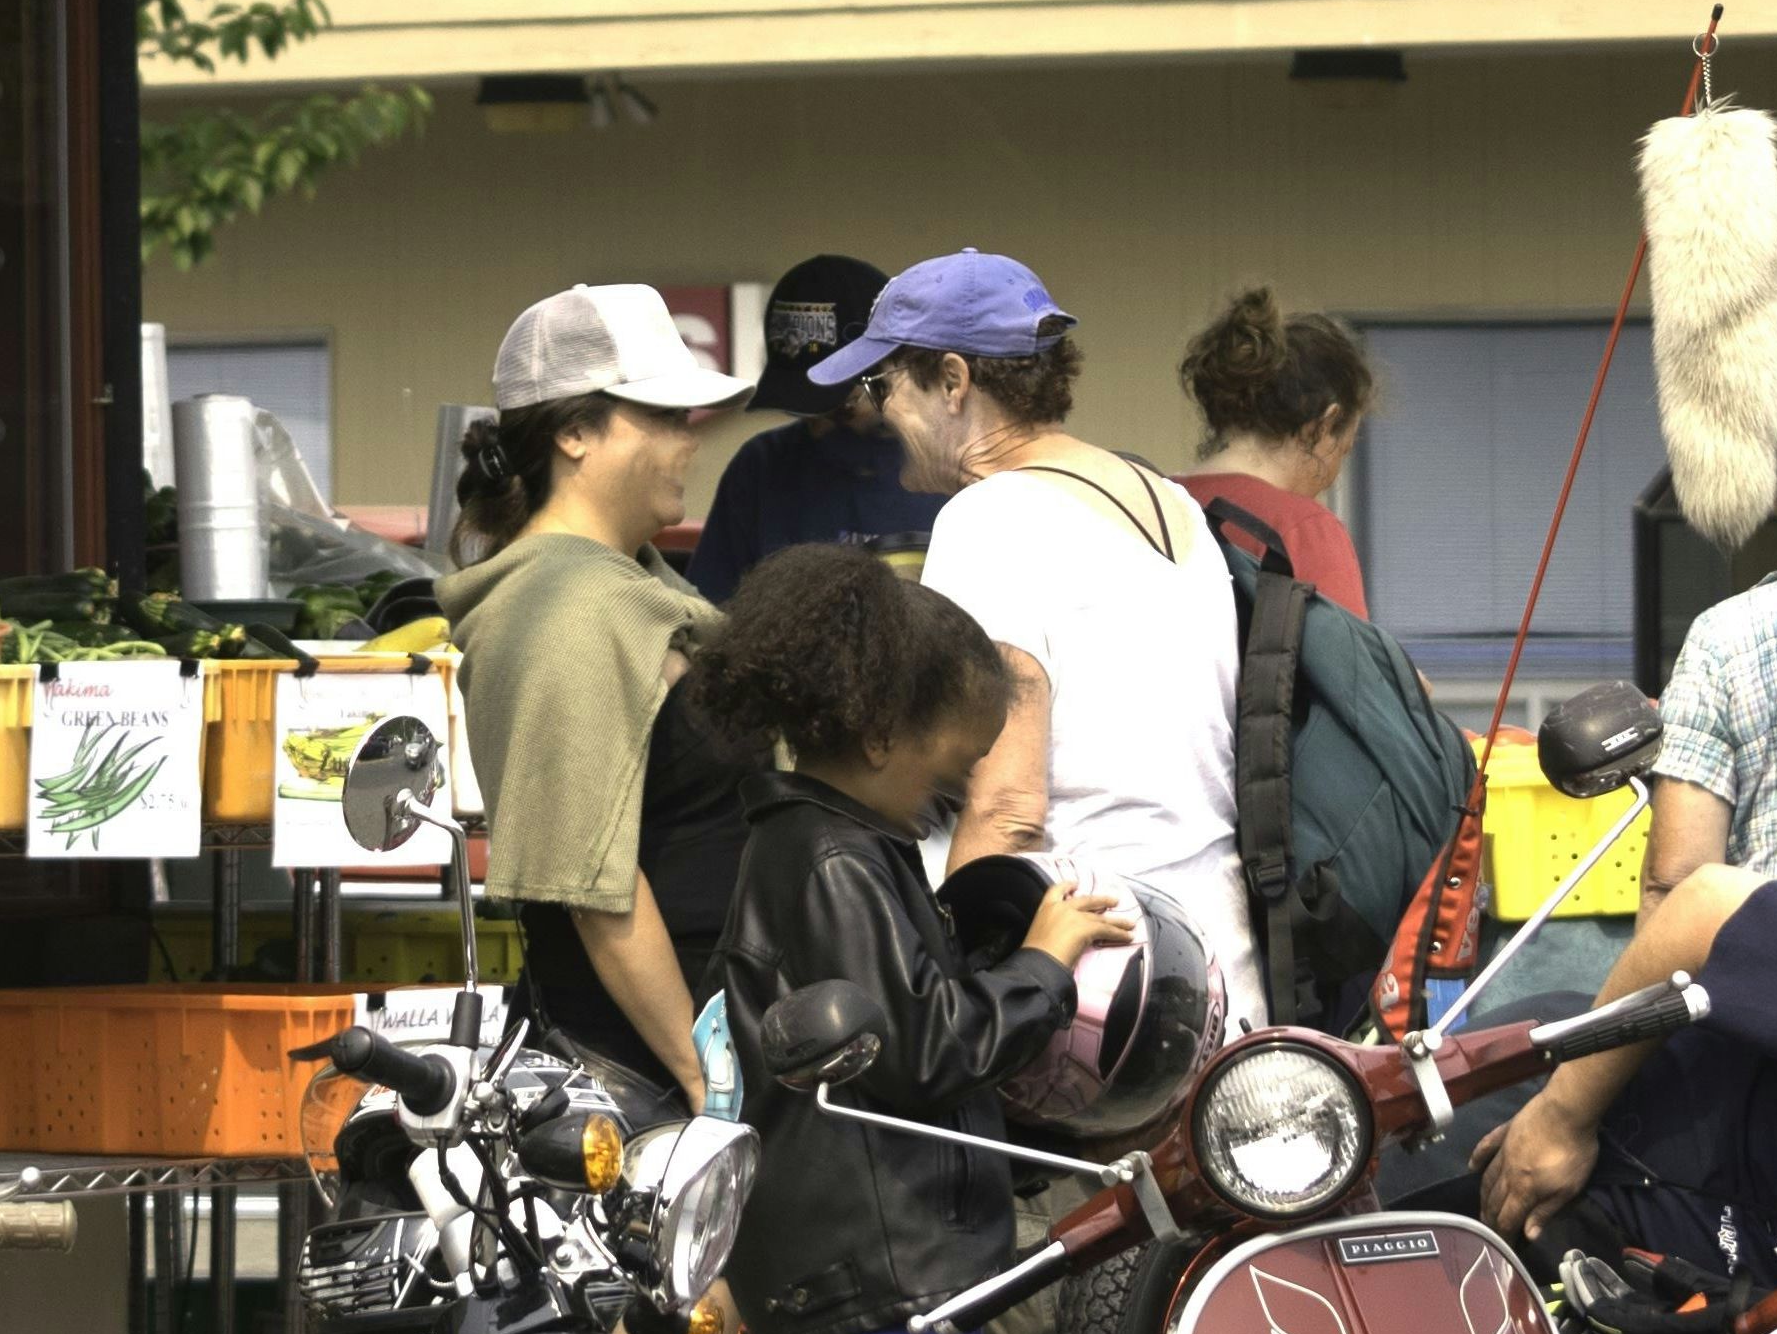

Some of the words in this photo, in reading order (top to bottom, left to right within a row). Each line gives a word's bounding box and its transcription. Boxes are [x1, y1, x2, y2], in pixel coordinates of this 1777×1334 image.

[61, 710, 117, 727] GREEN
[120, 710, 169, 727] BEANS
[381, 1008, 439, 1029] WALLA
[1350, 1238, 1429, 1255] PIAGGIO
